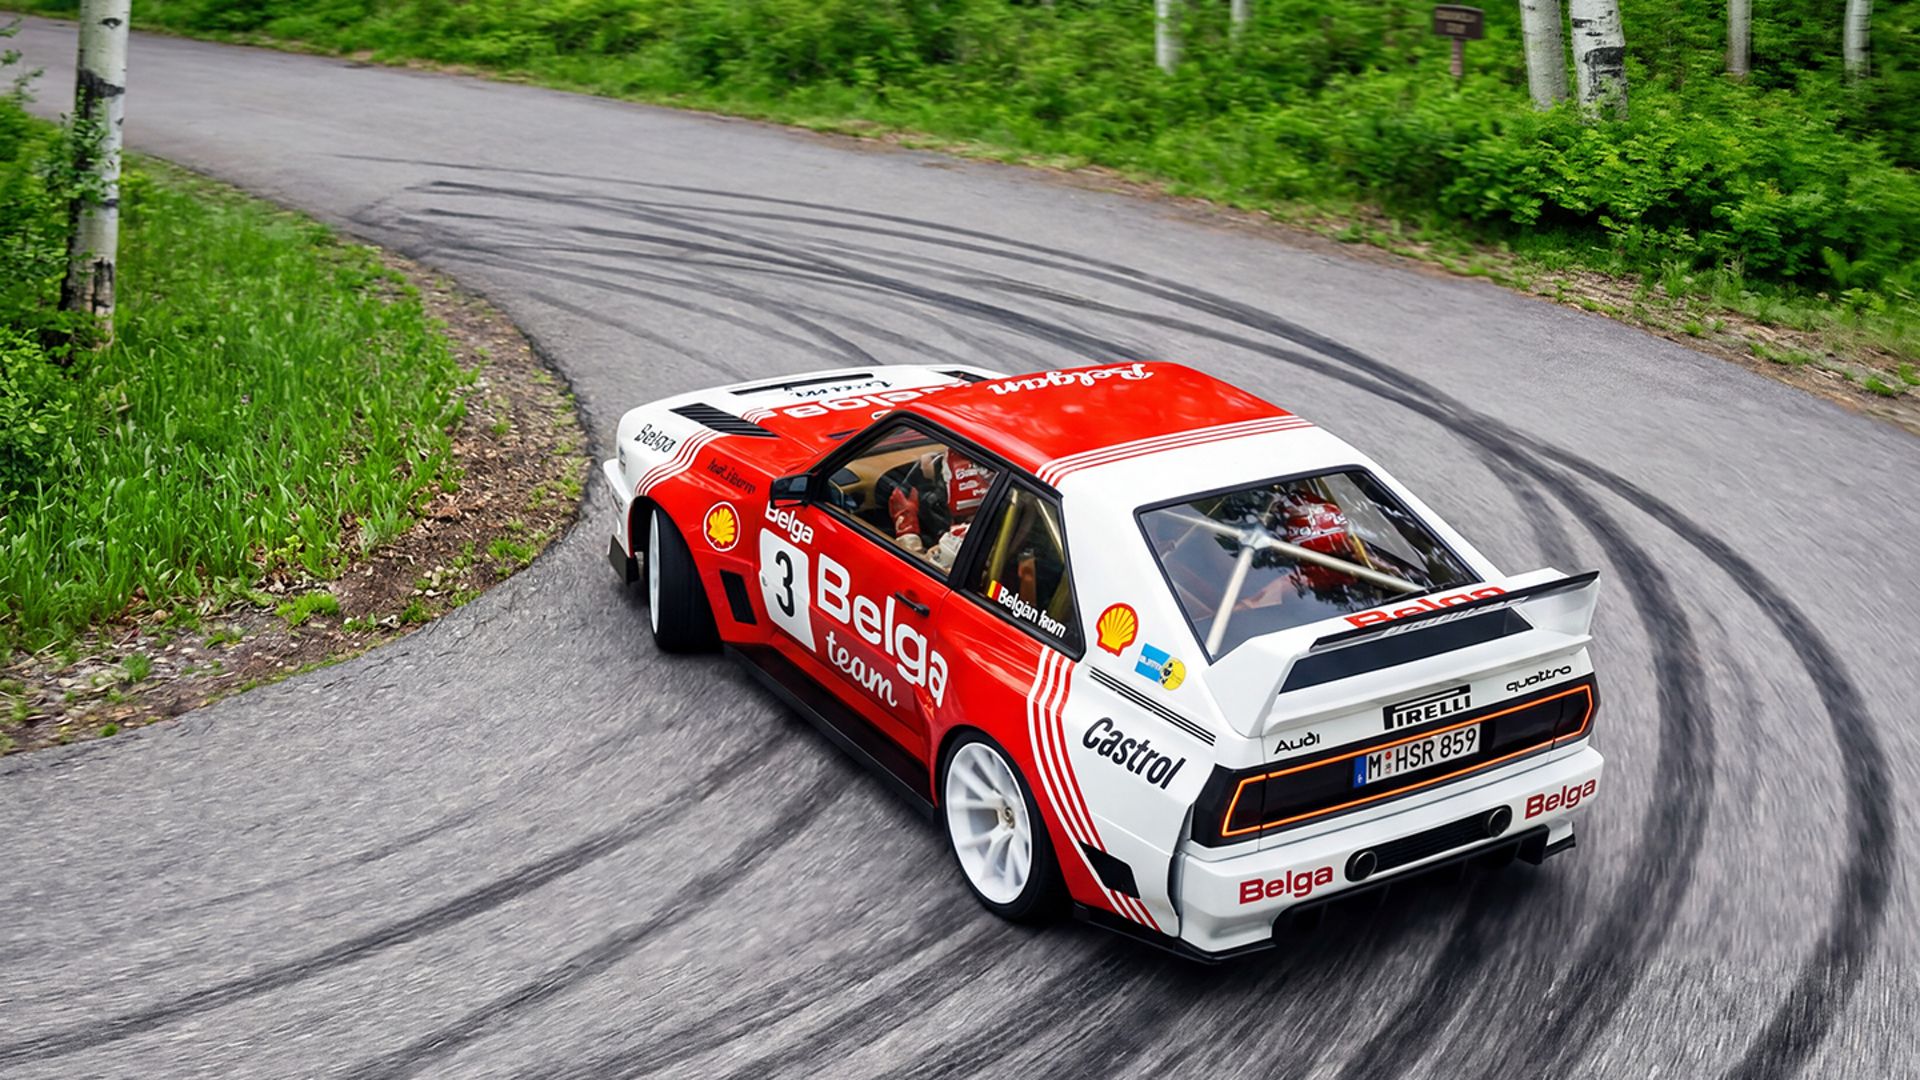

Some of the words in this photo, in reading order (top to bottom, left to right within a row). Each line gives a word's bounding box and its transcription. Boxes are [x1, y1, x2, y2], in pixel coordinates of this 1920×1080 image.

[634, 424, 677, 453] Belga
[774, 550, 794, 618] 3
[817, 552, 949, 709] Belga
[825, 630, 898, 707] team
[1506, 664, 1572, 692] quattro
[1382, 684, 1472, 730] PIRELLI
[1082, 716, 1187, 790] Castrol
[1274, 731, 1321, 755] Audi
[1368, 753, 1382, 780] M
[1395, 739, 1435, 773] HSR
[1440, 727, 1477, 759] 859
[1524, 778, 1597, 820] Belga
[1238, 865, 1333, 905] Belga
